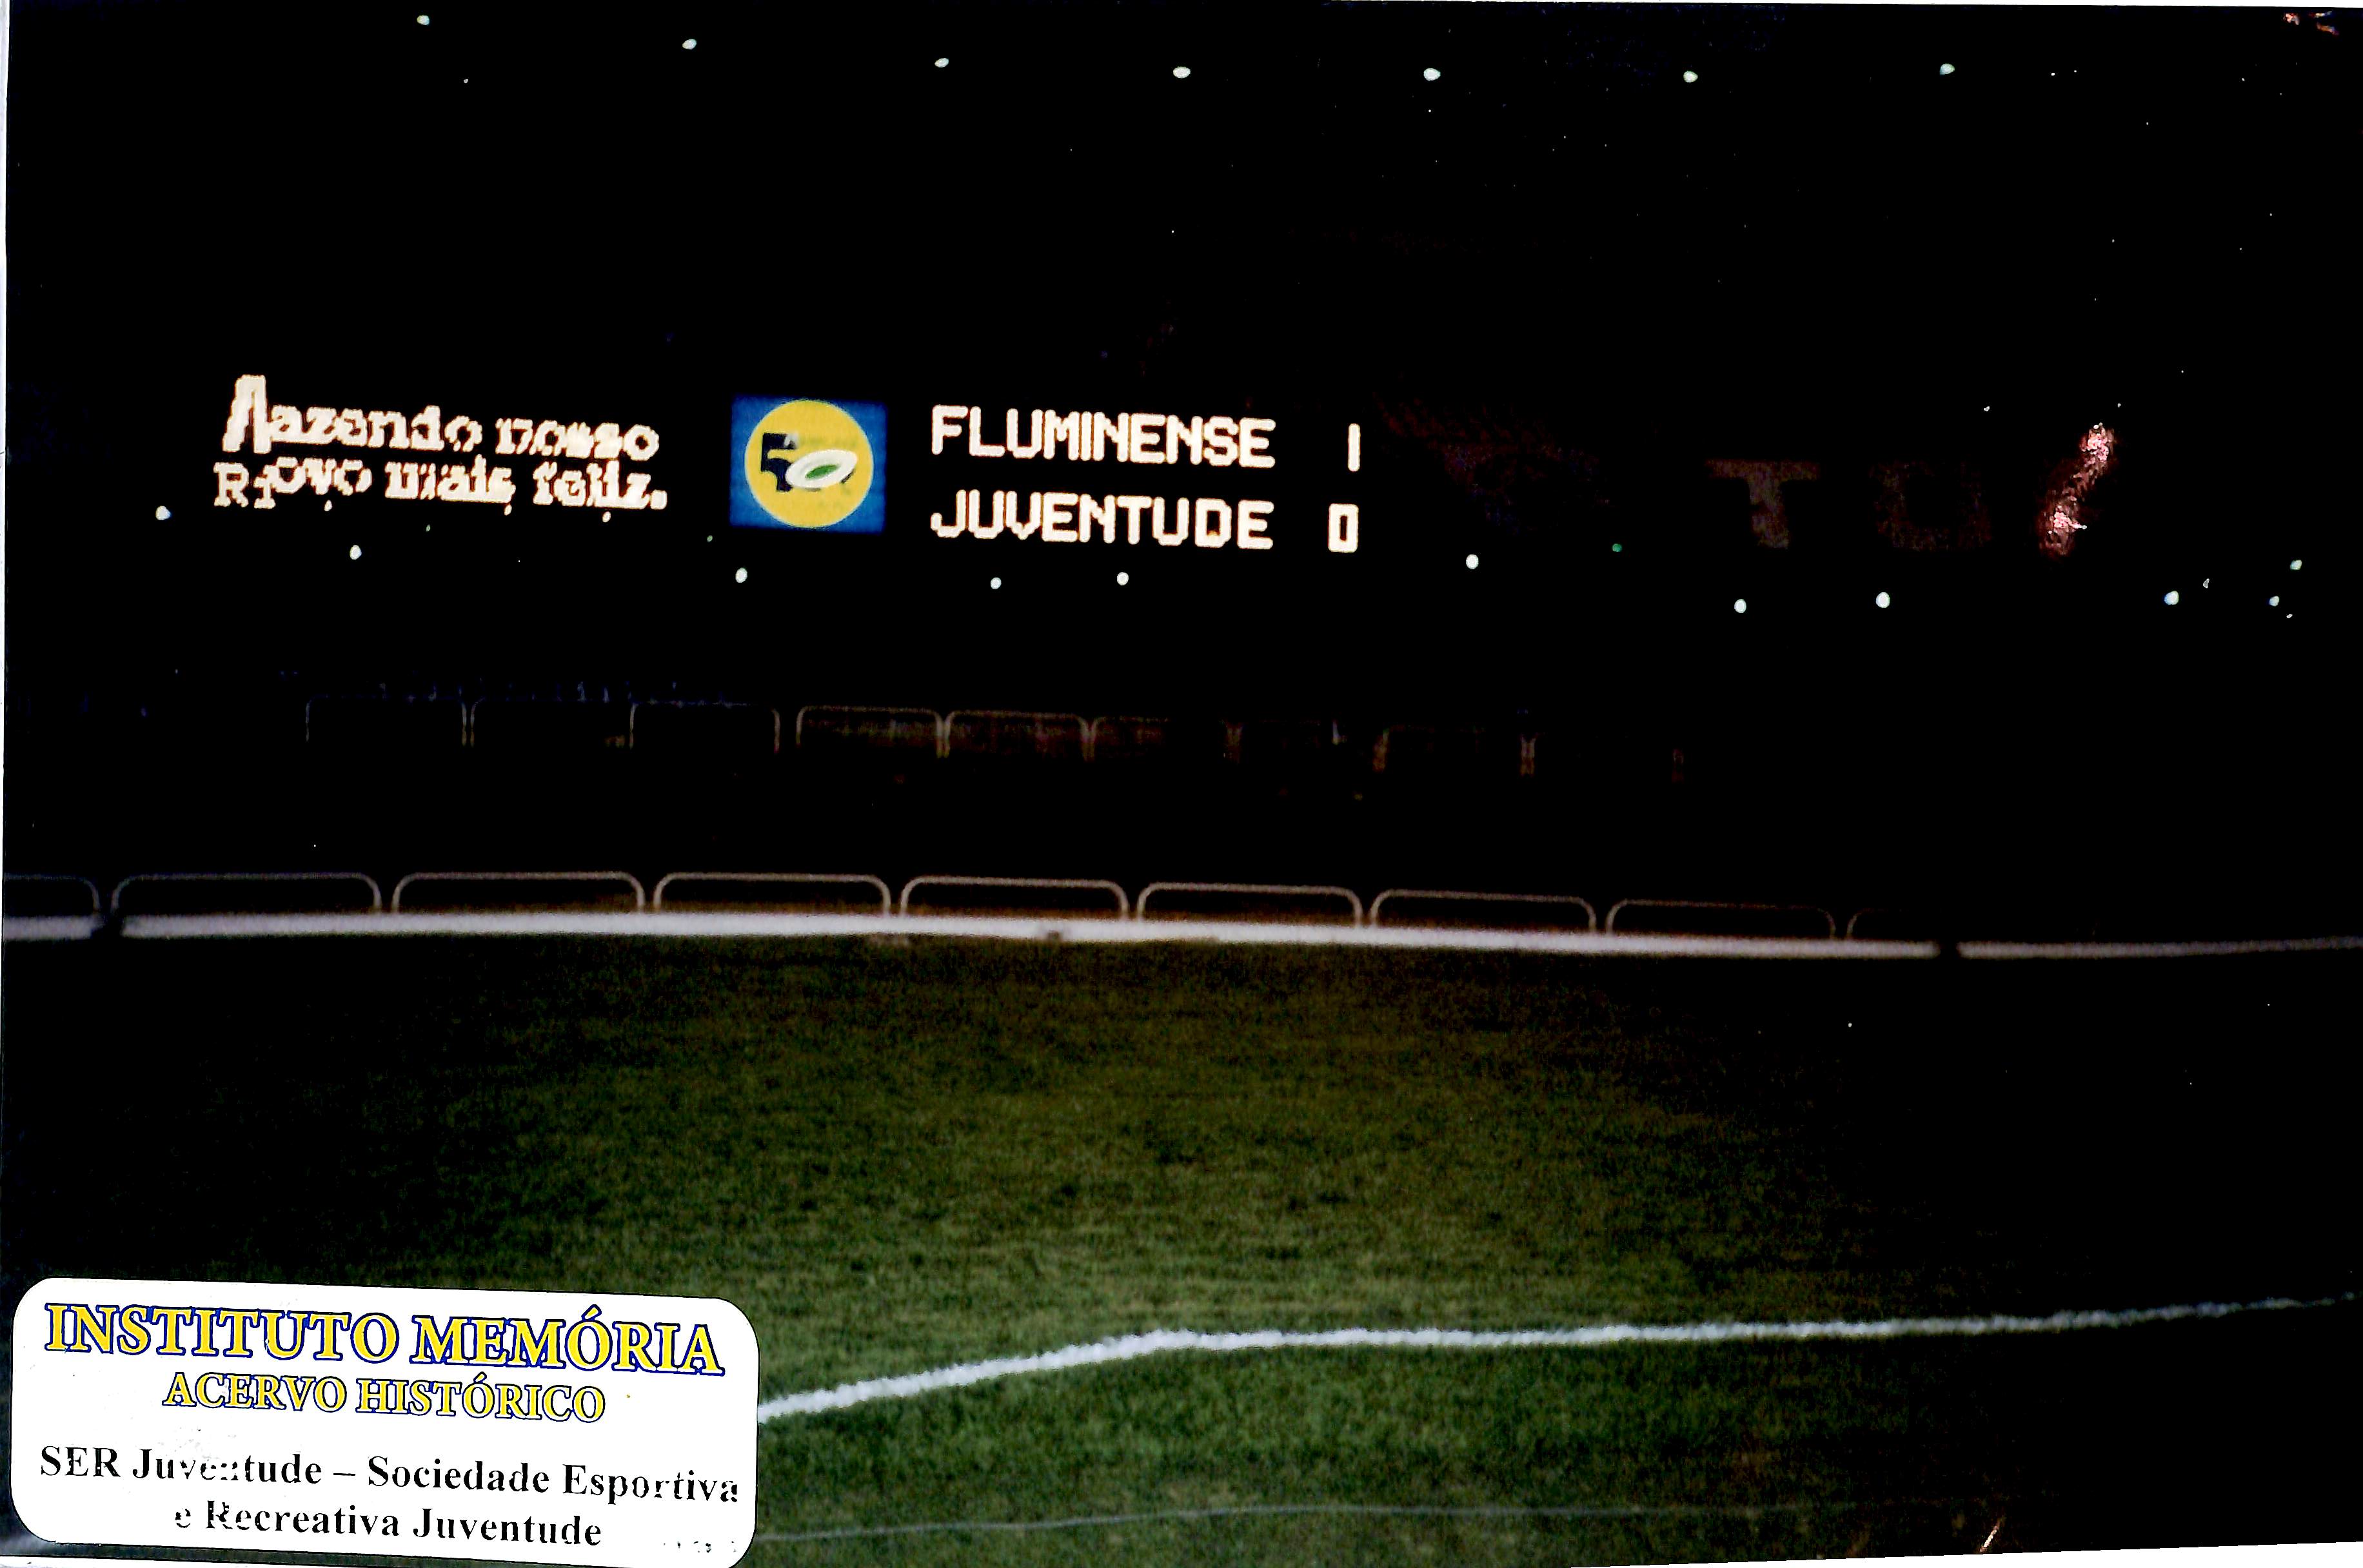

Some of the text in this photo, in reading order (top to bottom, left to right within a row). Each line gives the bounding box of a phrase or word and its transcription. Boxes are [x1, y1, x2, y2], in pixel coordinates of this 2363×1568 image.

[932, 404, 1276, 468] FLUMINENSE
[931, 489, 1359, 553] JUVENTUDE 0
